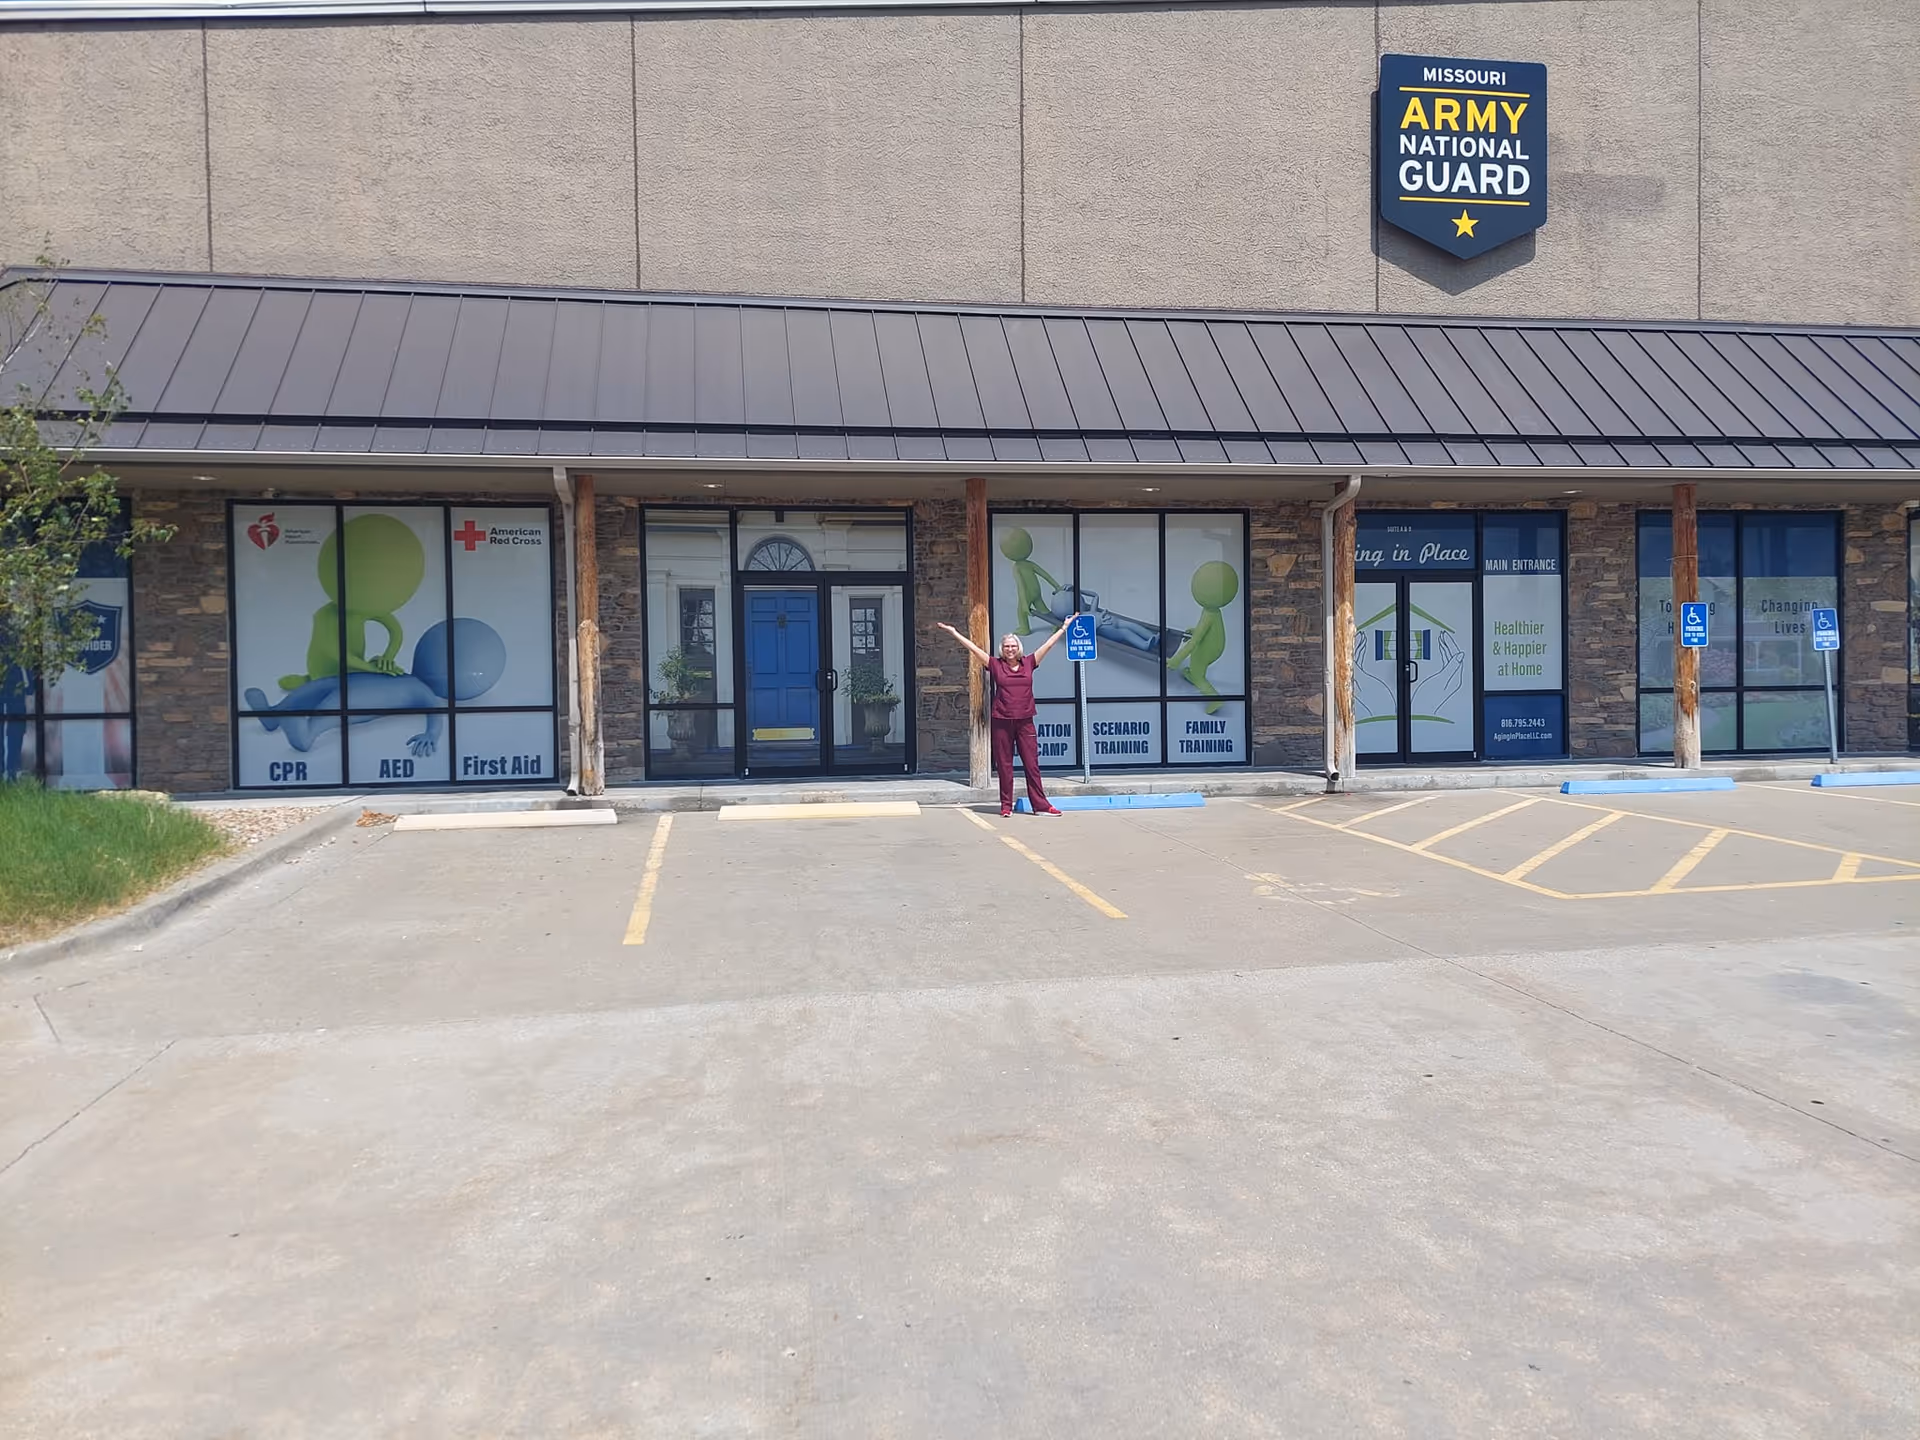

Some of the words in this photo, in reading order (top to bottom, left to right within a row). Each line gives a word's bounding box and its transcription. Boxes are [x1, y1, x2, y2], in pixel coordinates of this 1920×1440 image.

[1423, 67, 1506, 85] MISSOURI
[1400, 97, 1528, 134] ARMY
[1399, 134, 1530, 160] NATIONAL
[1399, 160, 1531, 196] GUARD
[490, 527, 542, 536] American
[489, 536, 510, 545] Red
[512, 536, 542, 545] Cross
[1355, 544, 1385, 567] ing
[1393, 544, 1412, 561] in
[1419, 543, 1470, 564] Place
[1485, 560, 1508, 571] MAIN
[1512, 559, 1556, 571] ENTRANCE
[1494, 620, 1545, 635] Healthier
[1775, 621, 1806, 634] Lives
[1493, 641, 1501, 656] &
[1504, 640, 1547, 658] Happier
[1498, 663, 1509, 676] at
[1511, 662, 1543, 676] Home
[1093, 721, 1150, 736] SCENARIO
[1186, 720, 1226, 734] FAMILY
[1500, 718, 1546, 728] 816.795.2443
[1037, 724, 1072, 738] ATION
[1094, 740, 1149, 754] TRAINING
[1178, 739, 1233, 753] TRAINING
[269, 761, 308, 781] CPR
[378, 759, 415, 778] AED
[463, 756, 507, 776] First
[511, 755, 541, 775] Aid
